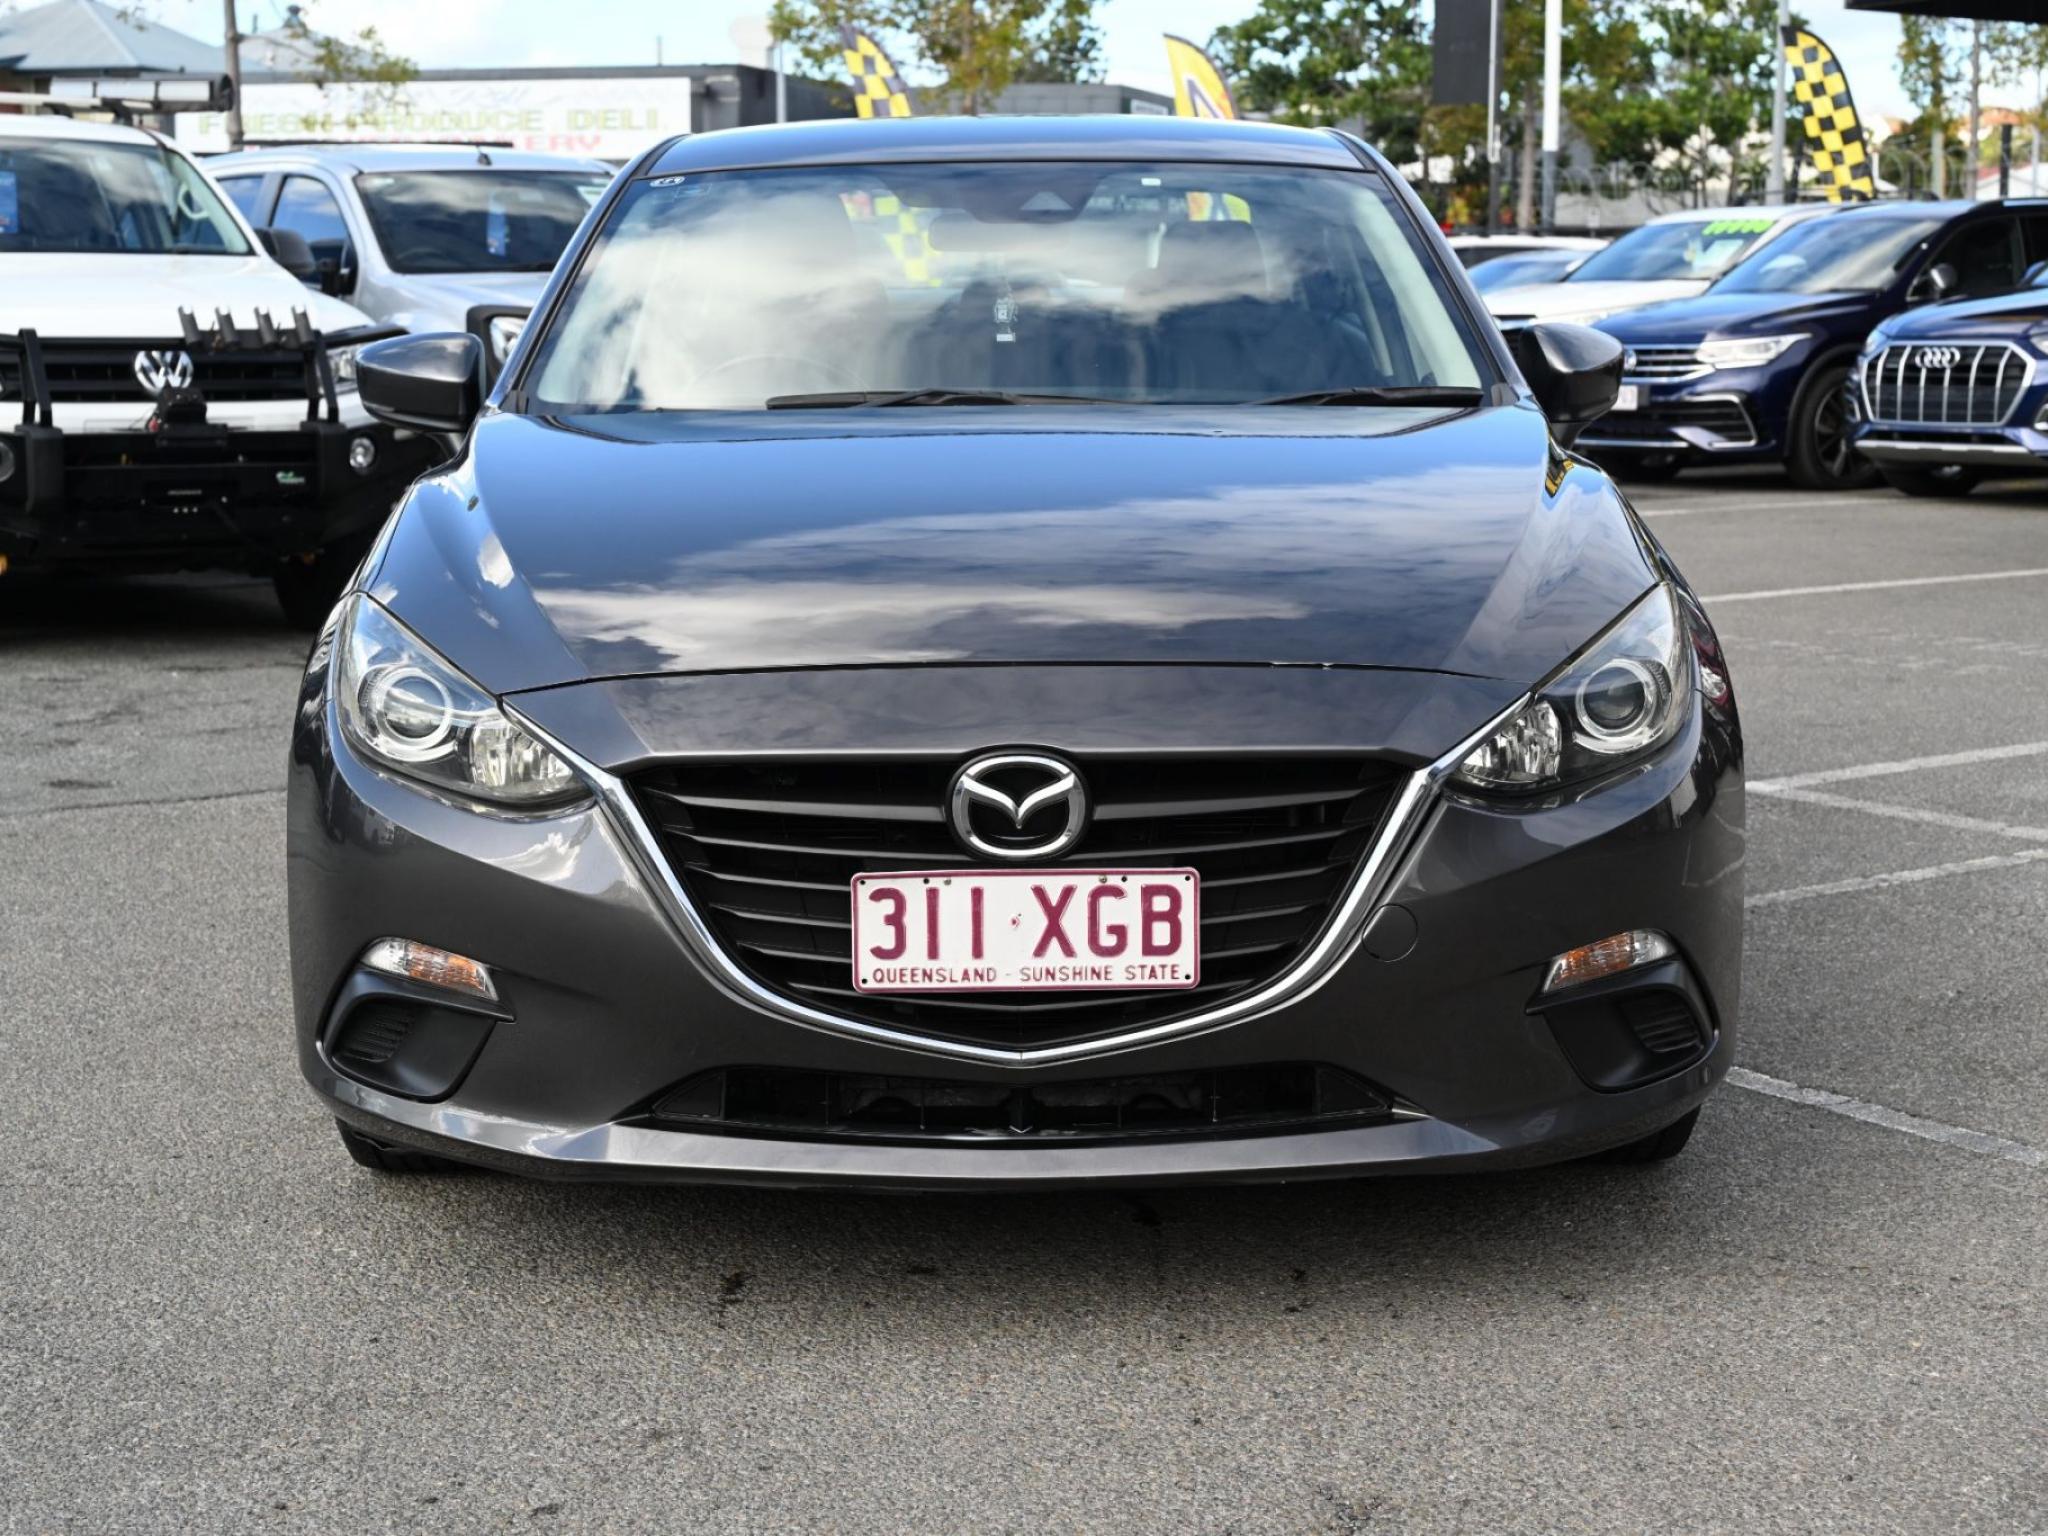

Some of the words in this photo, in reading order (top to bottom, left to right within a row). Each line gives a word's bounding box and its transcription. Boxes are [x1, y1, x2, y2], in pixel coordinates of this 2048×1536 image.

[199, 111, 334, 135] FESH
[567, 108, 658, 131] DELI
[869, 886, 985, 961] 311
[1030, 884, 1183, 959] XGB
[872, 967, 997, 984] QUEENSLAND
[1020, 965, 1113, 982] SUNSHINE
[1125, 964, 1181, 981] STATE
